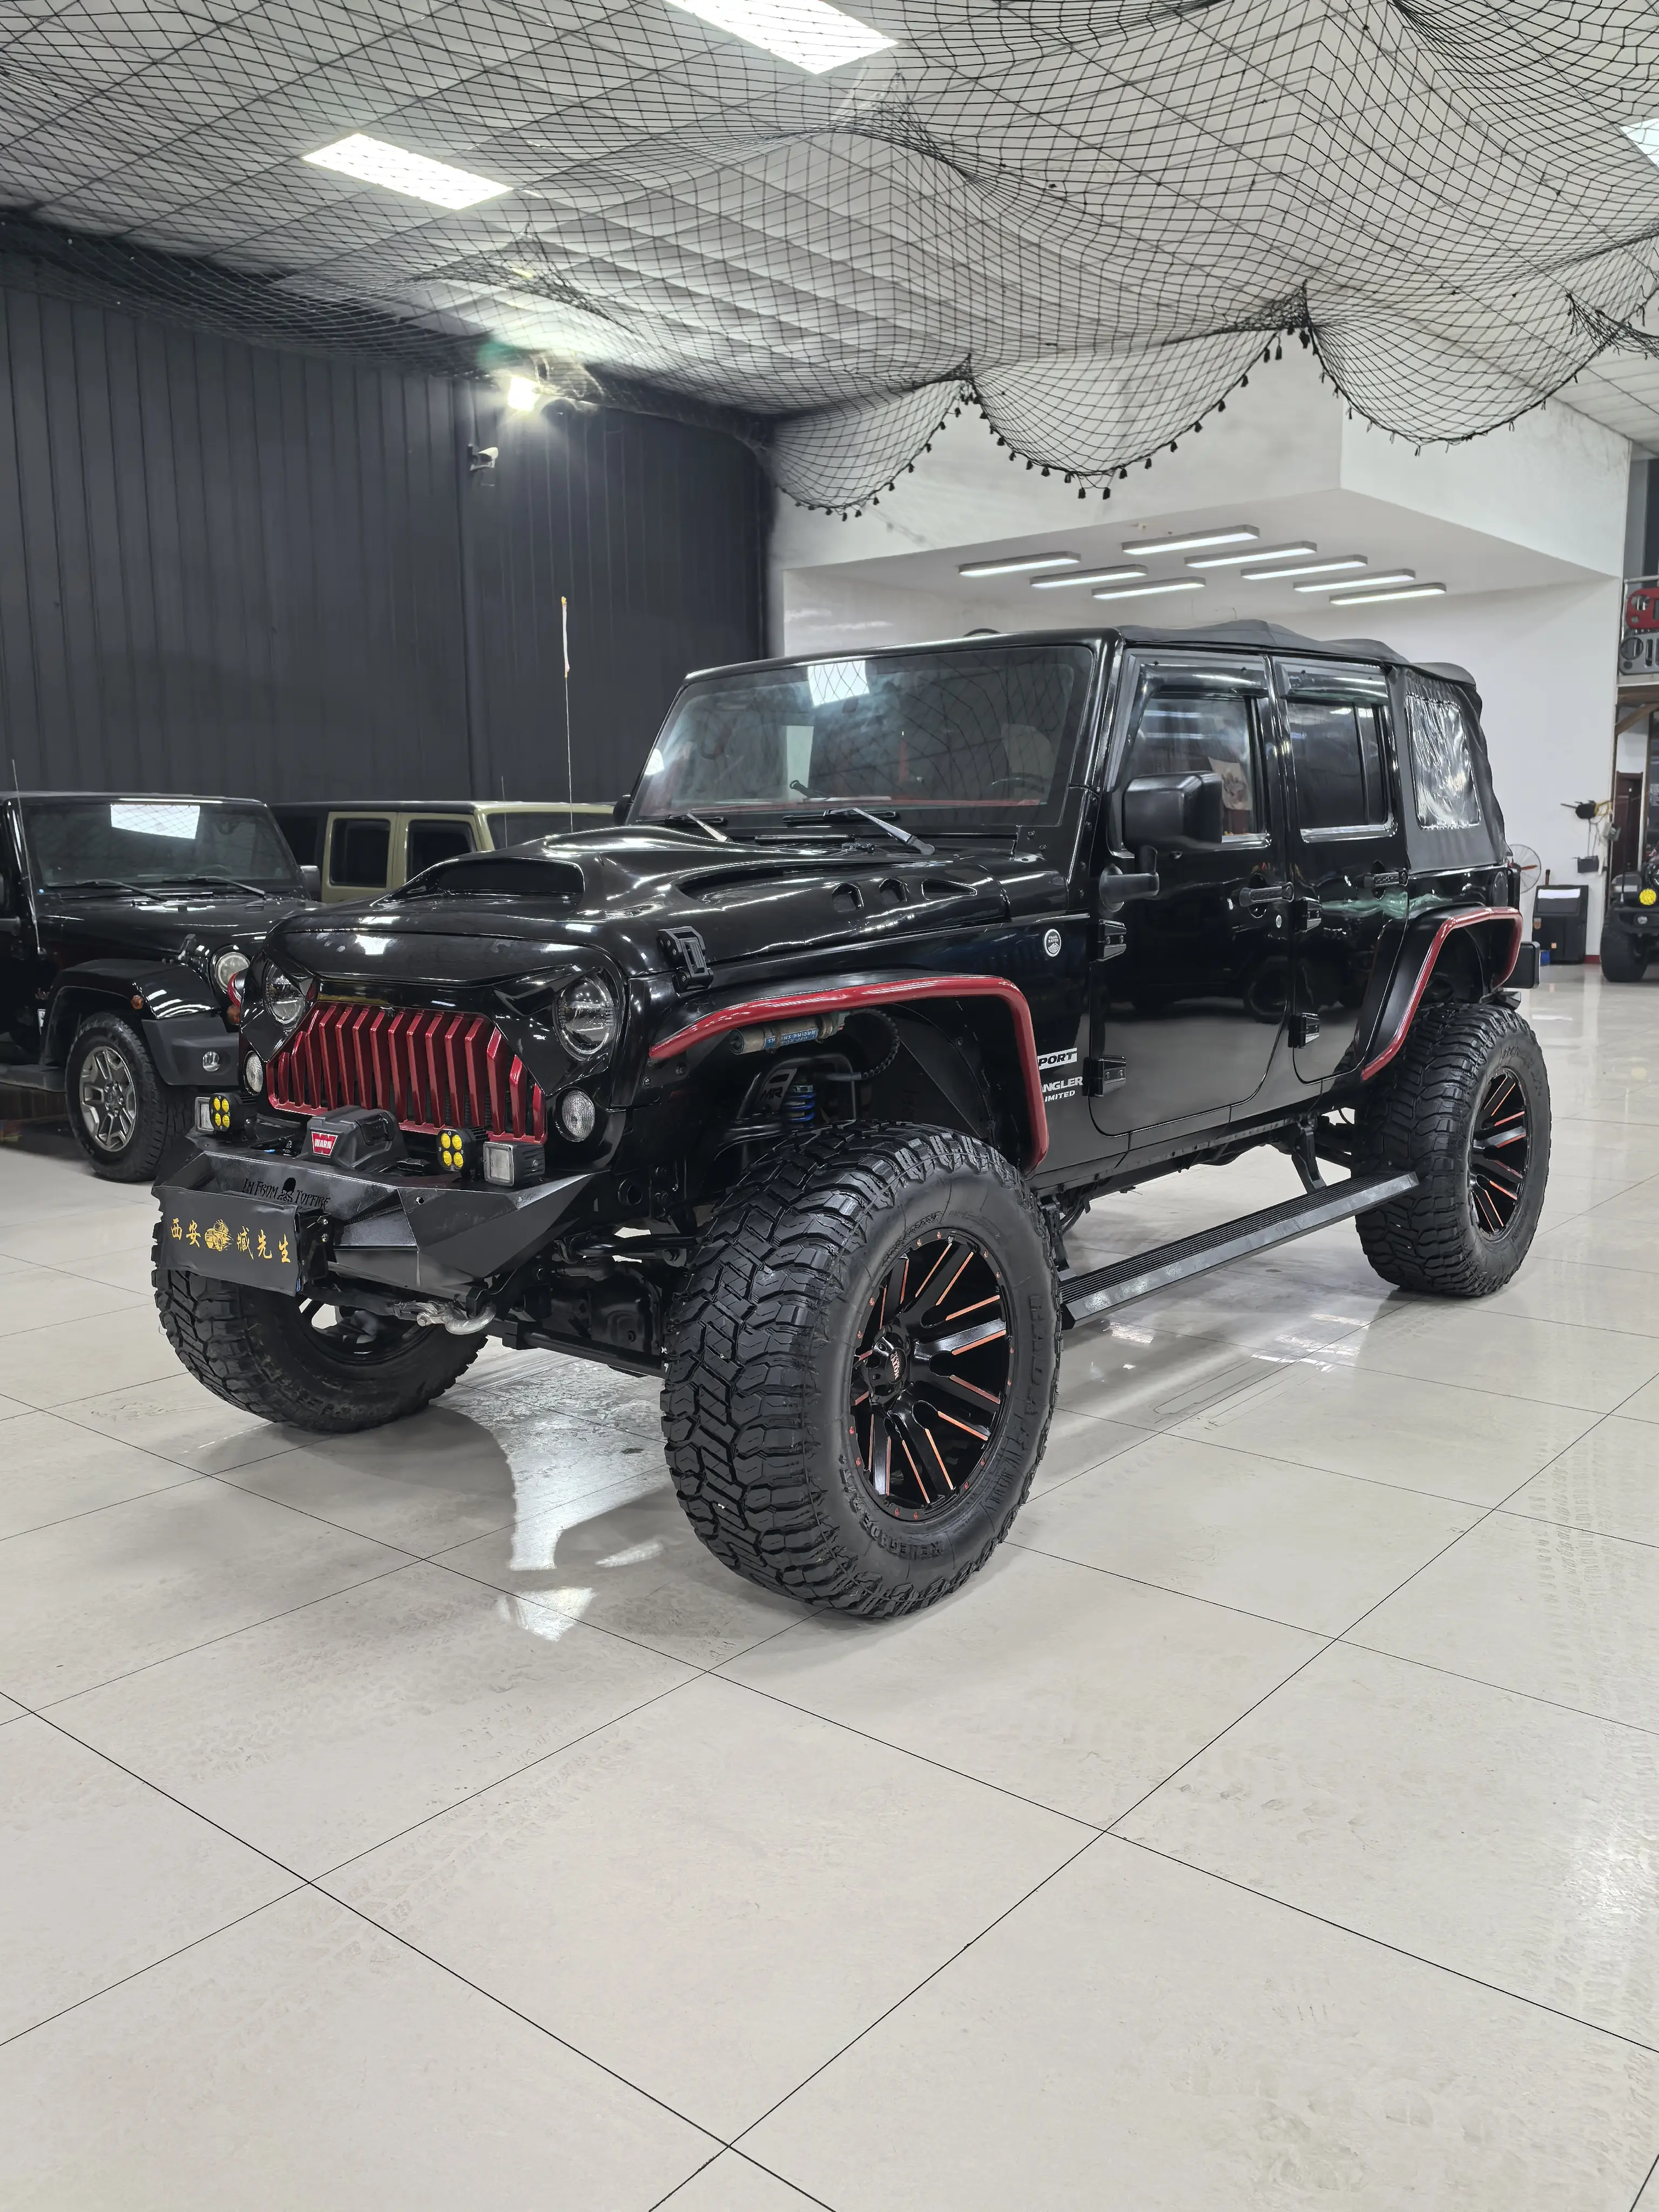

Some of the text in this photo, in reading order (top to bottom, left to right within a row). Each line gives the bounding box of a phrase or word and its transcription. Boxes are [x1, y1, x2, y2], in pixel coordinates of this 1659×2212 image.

[1038, 1051, 1077, 1067] PORT
[1041, 1076, 1083, 1093] NGLER
[1044, 1090, 1076, 1103] IMITED
[314, 1138, 332, 1150] WARN
[295, 1190, 331, 1210] TOPFIRE
